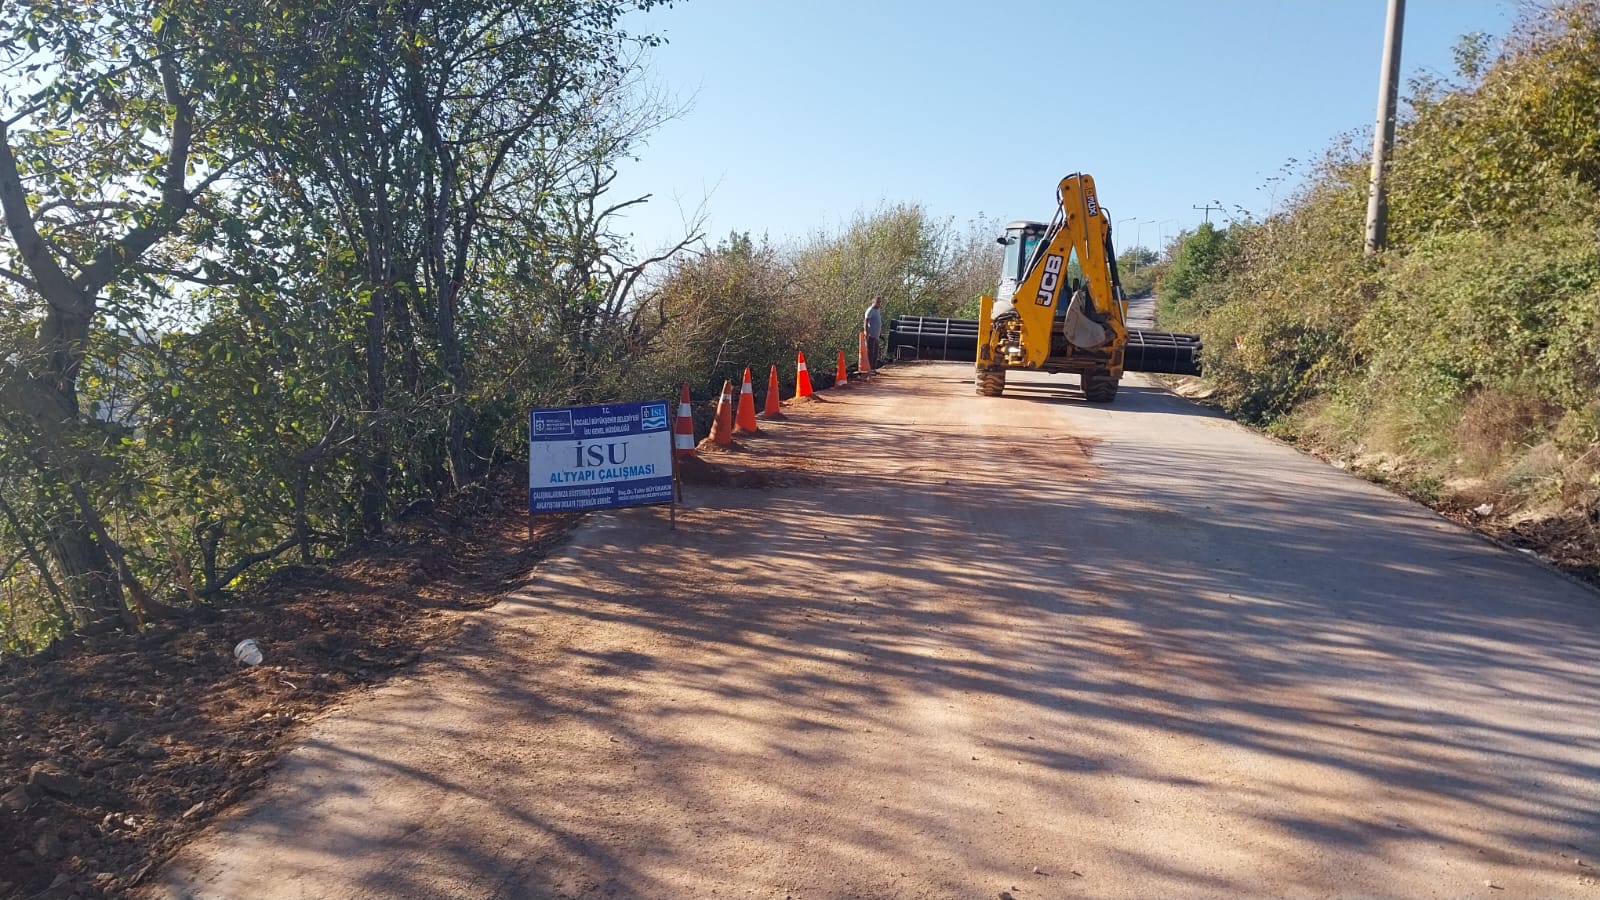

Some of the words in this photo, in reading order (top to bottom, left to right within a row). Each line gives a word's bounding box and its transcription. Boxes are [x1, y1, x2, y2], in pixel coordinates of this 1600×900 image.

[1038, 255, 1062, 306] JCB
[573, 440, 630, 468] İSU
[549, 469, 595, 483] ALTYAPI
[598, 463, 655, 482] ÇALIŞMASI
